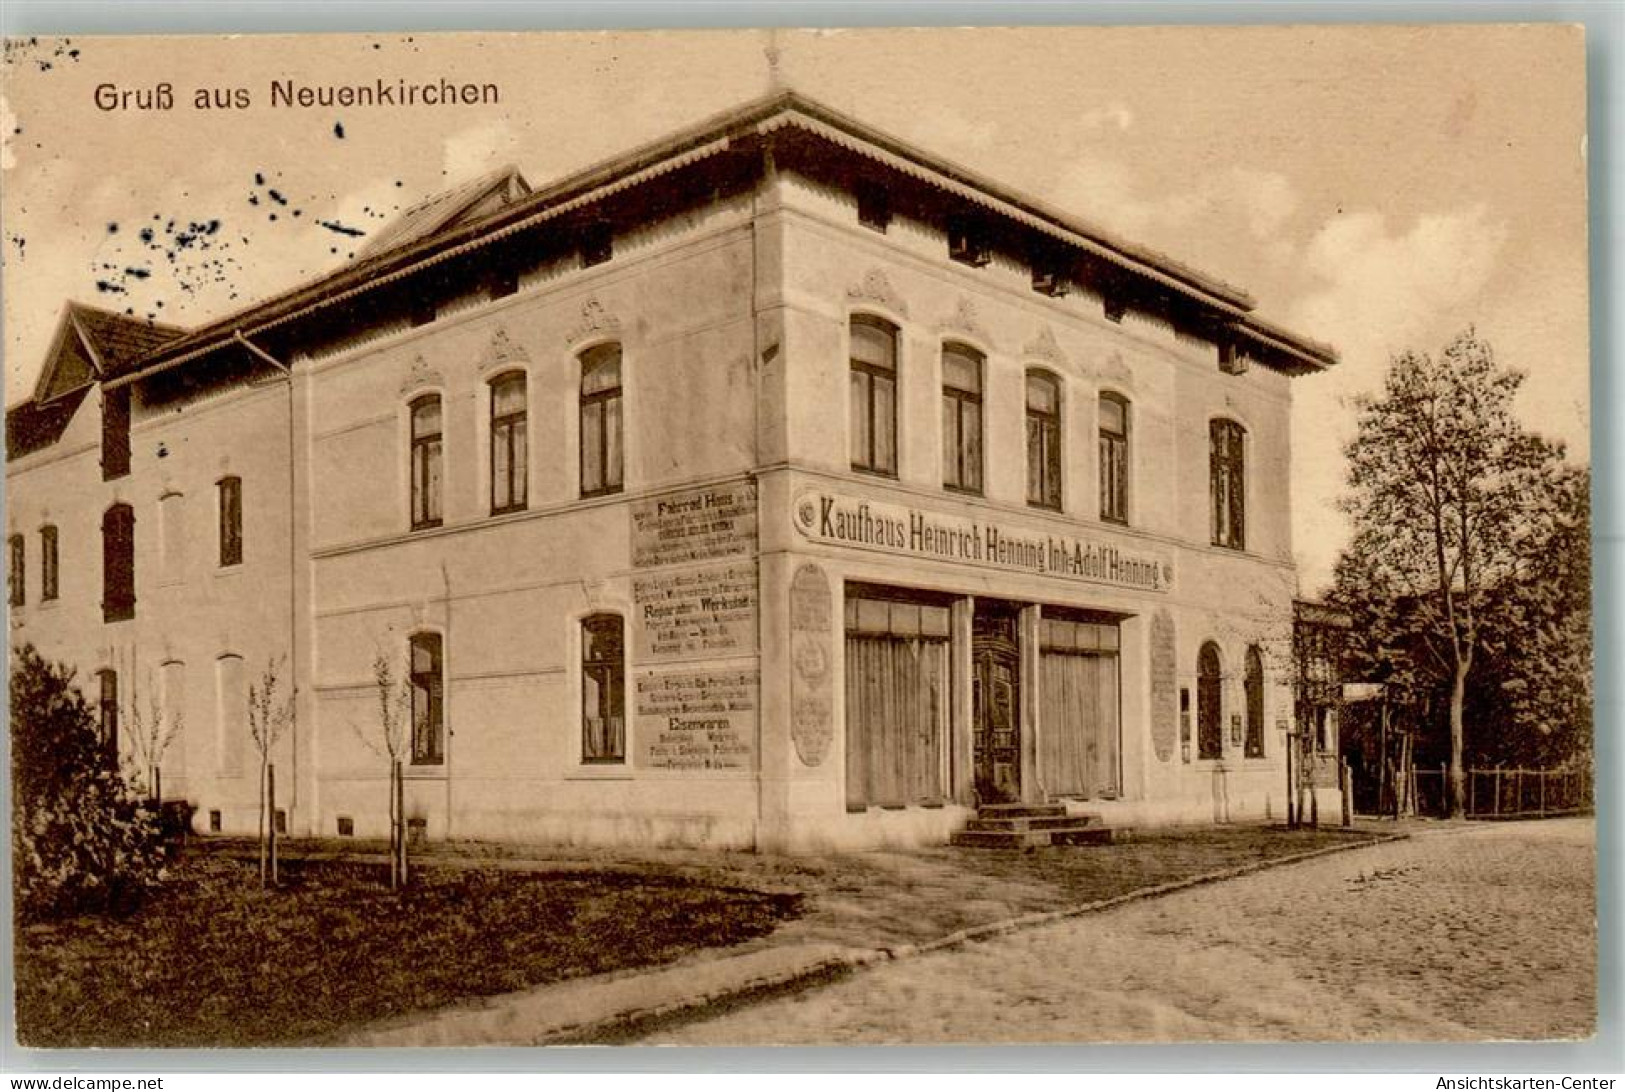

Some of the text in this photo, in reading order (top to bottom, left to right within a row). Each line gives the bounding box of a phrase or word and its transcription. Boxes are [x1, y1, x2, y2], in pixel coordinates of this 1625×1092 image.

[820, 496, 905, 548] Kaufhaus
[909, 511, 982, 560] Heinrich
[986, 525, 1045, 574] Henning
[1108, 549, 1160, 590] Henning
